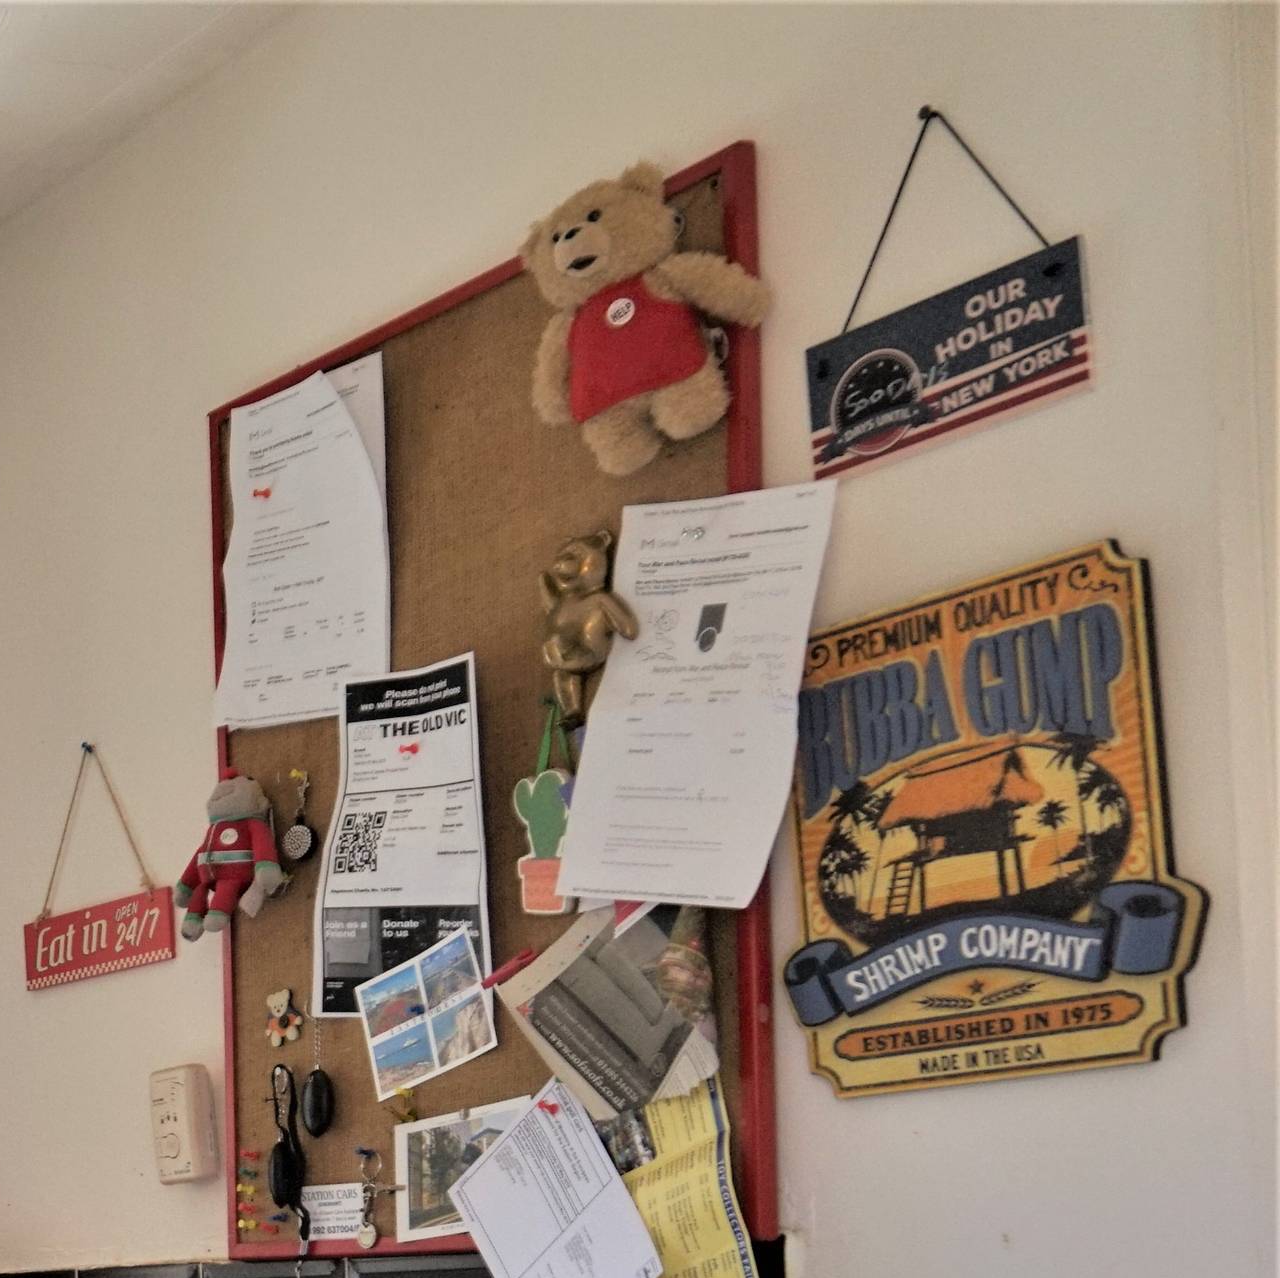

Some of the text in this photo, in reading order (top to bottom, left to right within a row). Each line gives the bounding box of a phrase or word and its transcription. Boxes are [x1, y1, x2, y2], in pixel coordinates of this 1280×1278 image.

[964, 278, 1027, 319] OUR
[935, 294, 1064, 362] HOLIDAY
[990, 338, 1014, 359] IN
[941, 341, 1069, 414] NEW YORK
[836, 609, 944, 668] PREMIUM
[952, 573, 1060, 633] QUALITY
[360, 702, 375, 711] we
[376, 699, 393, 709] will
[395, 698, 419, 708] scan
[385, 688, 419, 699] Please
[380, 720, 420, 738] THE
[422, 714, 443, 733] OLD
[445, 709, 467, 727] VIC
[797, 602, 1124, 818] BUBBA GUMP
[114, 901, 139, 922] OPEN
[325, 921, 345, 930] Join
[382, 919, 420, 928] Donate
[36, 911, 108, 972] Eat in
[114, 907, 161, 952] 24/7
[325, 930, 357, 938] Friend
[382, 930, 409, 938] to us
[845, 924, 1093, 1002] SHRIMP COMPANY
[862, 1003, 1113, 1052] ESTABLISHED IN 1975
[919, 1044, 1045, 1074] MADE IN THE USA
[302, 1189, 358, 1201] STATION CARS
[719, 1184, 747, 1252] COLLECTORS
